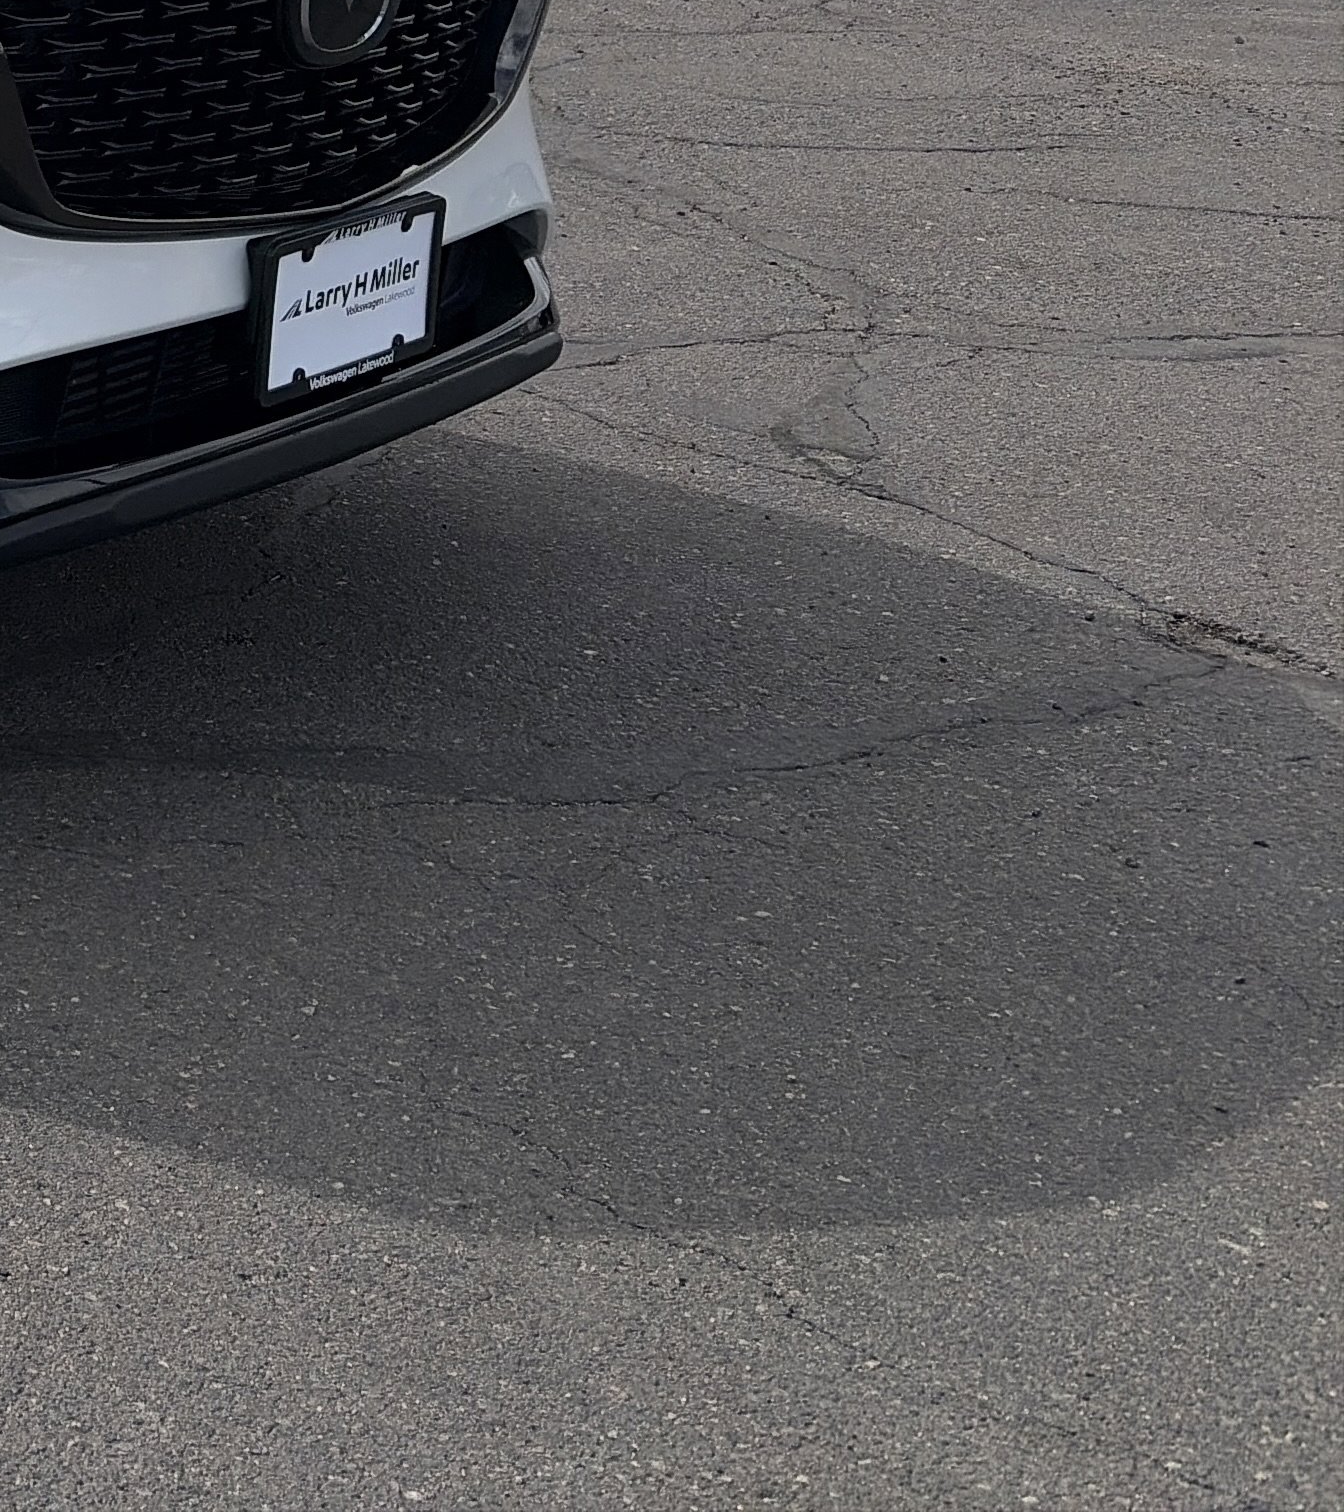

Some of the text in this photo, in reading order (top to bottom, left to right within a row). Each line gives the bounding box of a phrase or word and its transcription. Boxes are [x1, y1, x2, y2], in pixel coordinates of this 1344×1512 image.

[305, 257, 420, 313] Larry H Miller
[345, 297, 384, 317] Volkswagen
[309, 349, 395, 391] Volkswagen Lakewood
